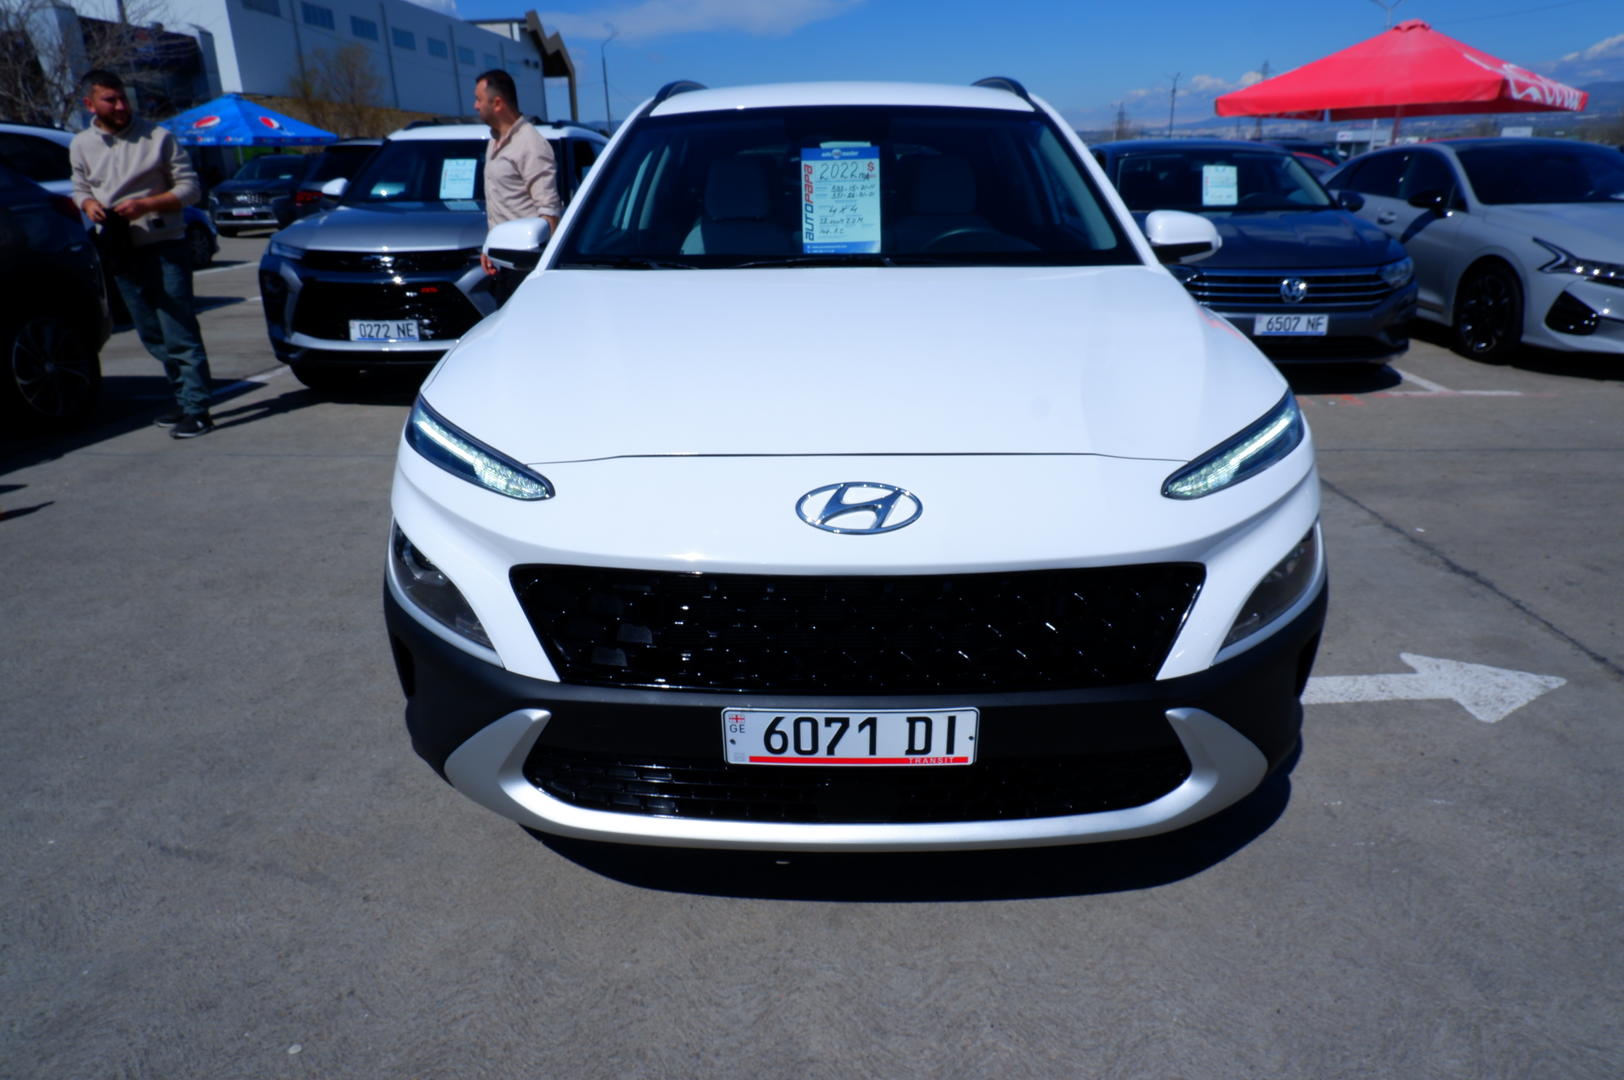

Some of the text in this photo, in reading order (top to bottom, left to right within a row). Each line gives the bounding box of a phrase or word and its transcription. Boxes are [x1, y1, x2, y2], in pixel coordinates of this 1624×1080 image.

[820, 161, 858, 180] 2022
[359, 323, 416, 338] 0272 NE
[1266, 316, 1301, 331] 6507
[729, 723, 746, 734] GE
[763, 715, 956, 756] 6071 DI
